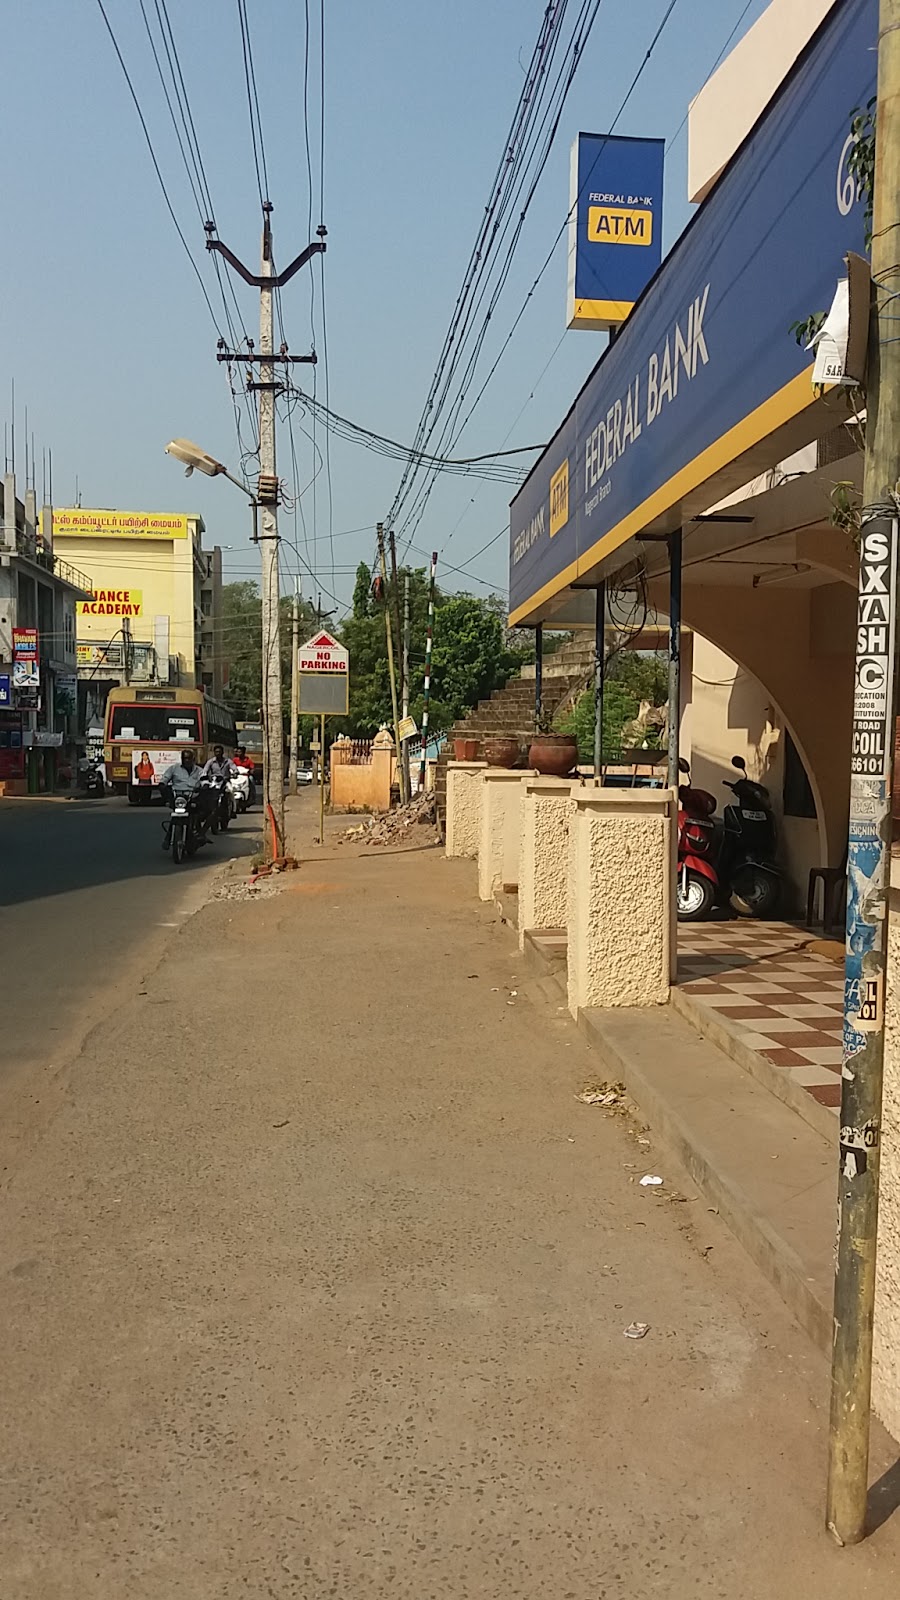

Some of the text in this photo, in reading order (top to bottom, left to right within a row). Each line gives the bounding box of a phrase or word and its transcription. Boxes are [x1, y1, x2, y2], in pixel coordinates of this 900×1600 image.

[588, 192, 625, 204] FEDERAL
[596, 215, 645, 237] ATM
[584, 282, 711, 494] FEDERAL BANK
[530, 504, 545, 546] BANK
[82, 603, 141, 615] ACADEMY
[316, 652, 331, 660] NO
[301, 660, 346, 670] PARKING
[857, 721, 881, 730] ROAD
